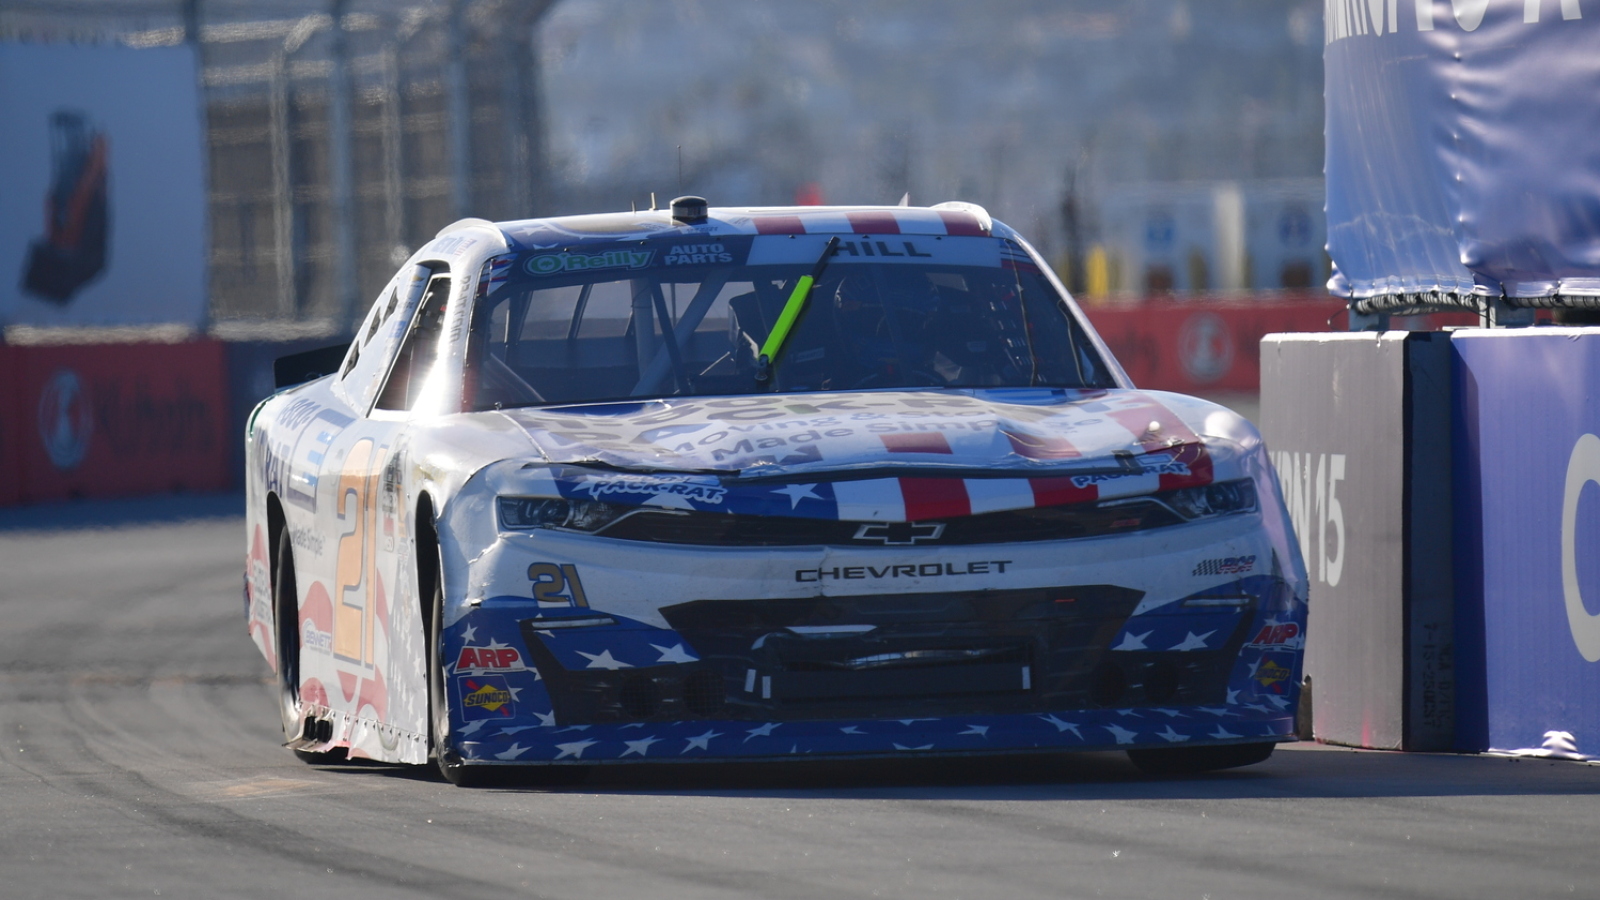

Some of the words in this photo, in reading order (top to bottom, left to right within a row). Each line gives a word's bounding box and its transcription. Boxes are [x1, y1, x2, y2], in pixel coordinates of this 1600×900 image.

[664, 253, 733, 265] PARTS
[670, 243, 725, 254] AUTO
[825, 241, 932, 257] HILL
[530, 251, 650, 273] O'Reilly
[711, 428, 854, 461] Made
[593, 480, 724, 500] PACK-RAT
[1315, 453, 1346, 588] 15
[333, 437, 388, 670] 21
[795, 560, 1013, 582] CHEVROLET
[527, 562, 590, 608] 21
[456, 647, 519, 669] ARP
[466, 690, 510, 706] SUNOCO
